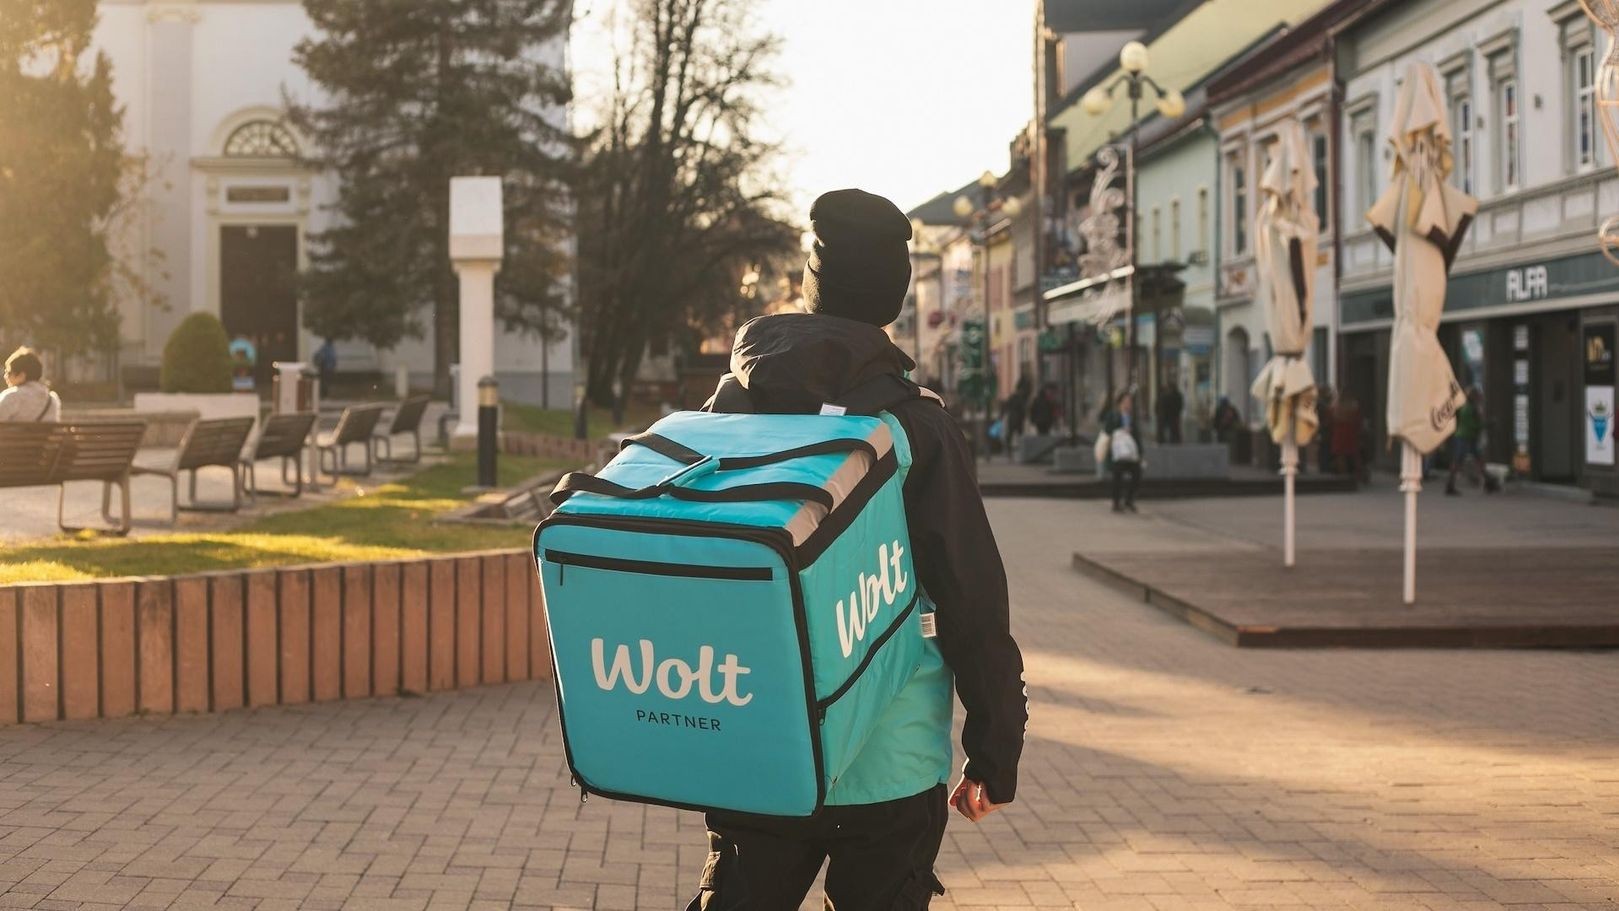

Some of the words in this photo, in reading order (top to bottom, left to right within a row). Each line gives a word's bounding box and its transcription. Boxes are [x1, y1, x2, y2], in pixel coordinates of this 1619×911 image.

[1506, 265, 1547, 301] ALFA
[836, 540, 907, 658] Wolt
[591, 638, 753, 706] Wolt
[636, 709, 721, 731] PARTNER
